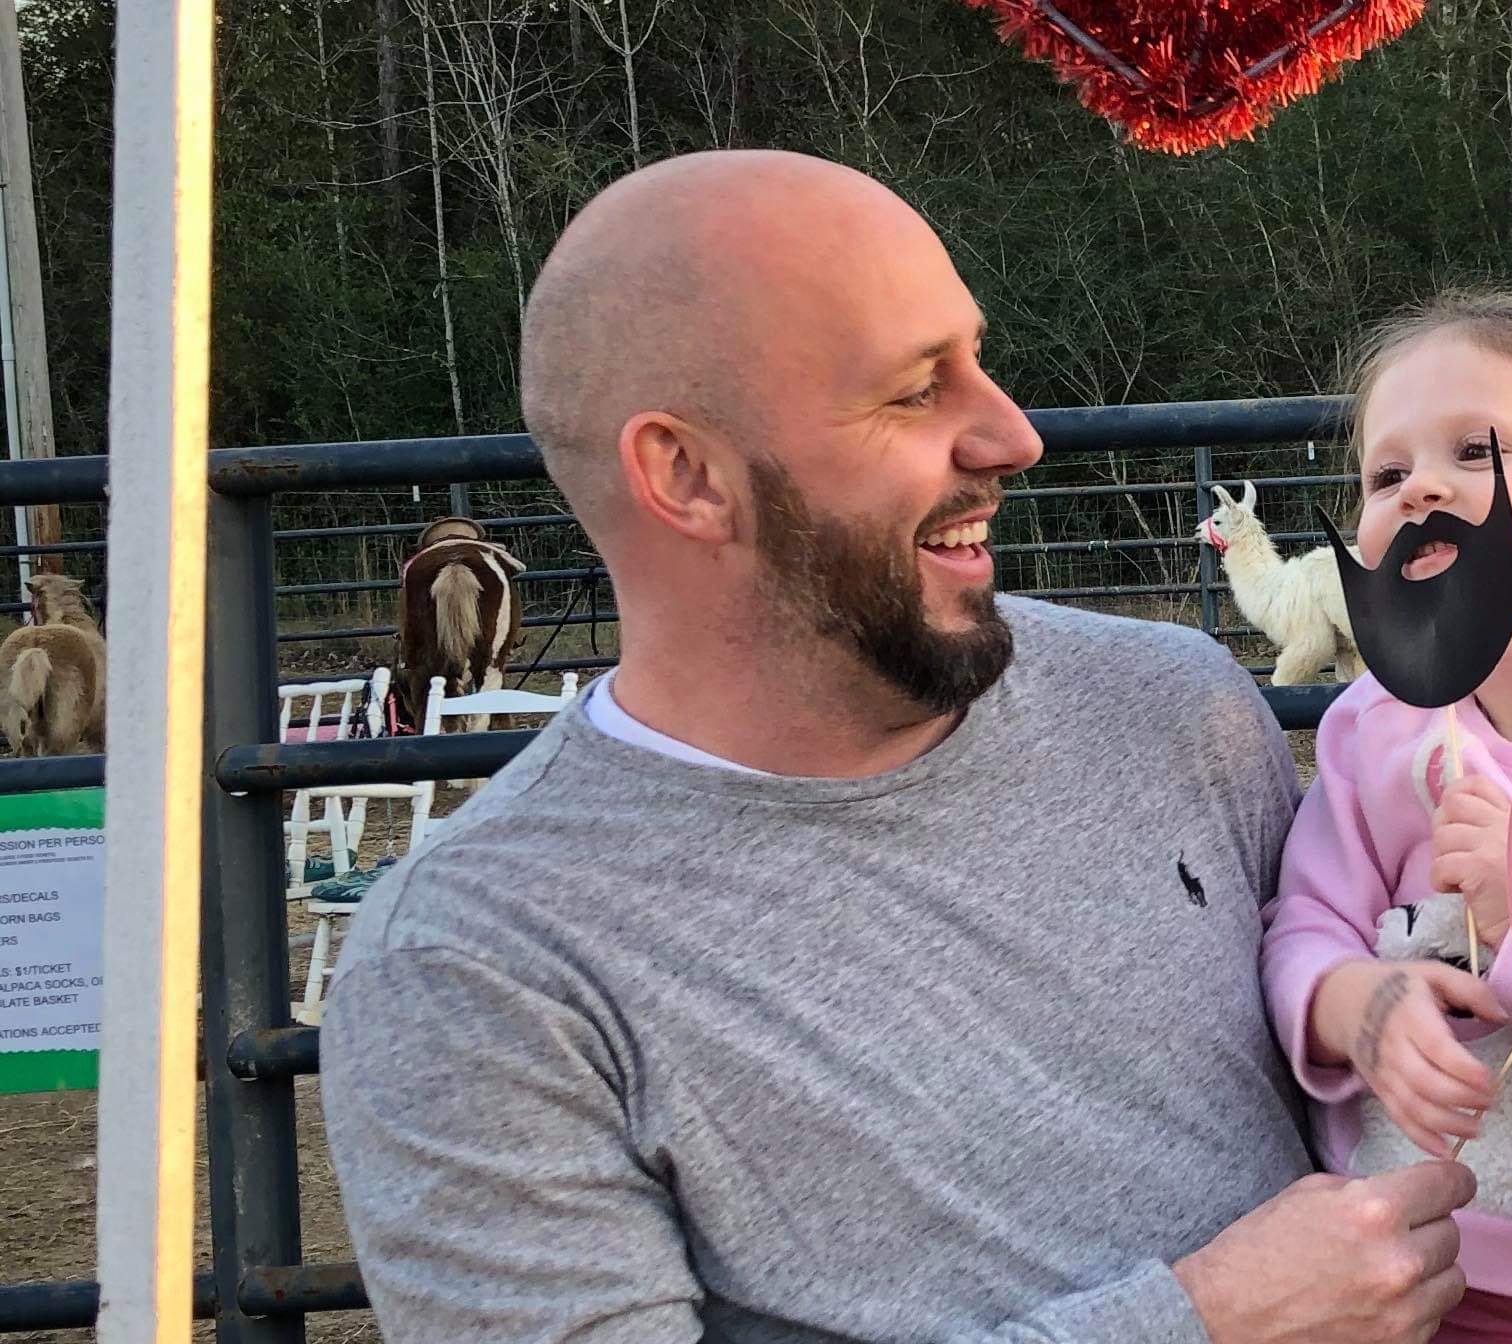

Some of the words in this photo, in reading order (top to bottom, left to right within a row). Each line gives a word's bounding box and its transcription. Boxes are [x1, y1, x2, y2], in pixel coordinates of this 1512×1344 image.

[39, 838, 62, 848] PER
[0, 890, 59, 904] S/DECALS
[28, 911, 61, 923] BAGS
[33, 993, 79, 1006] BASKET
